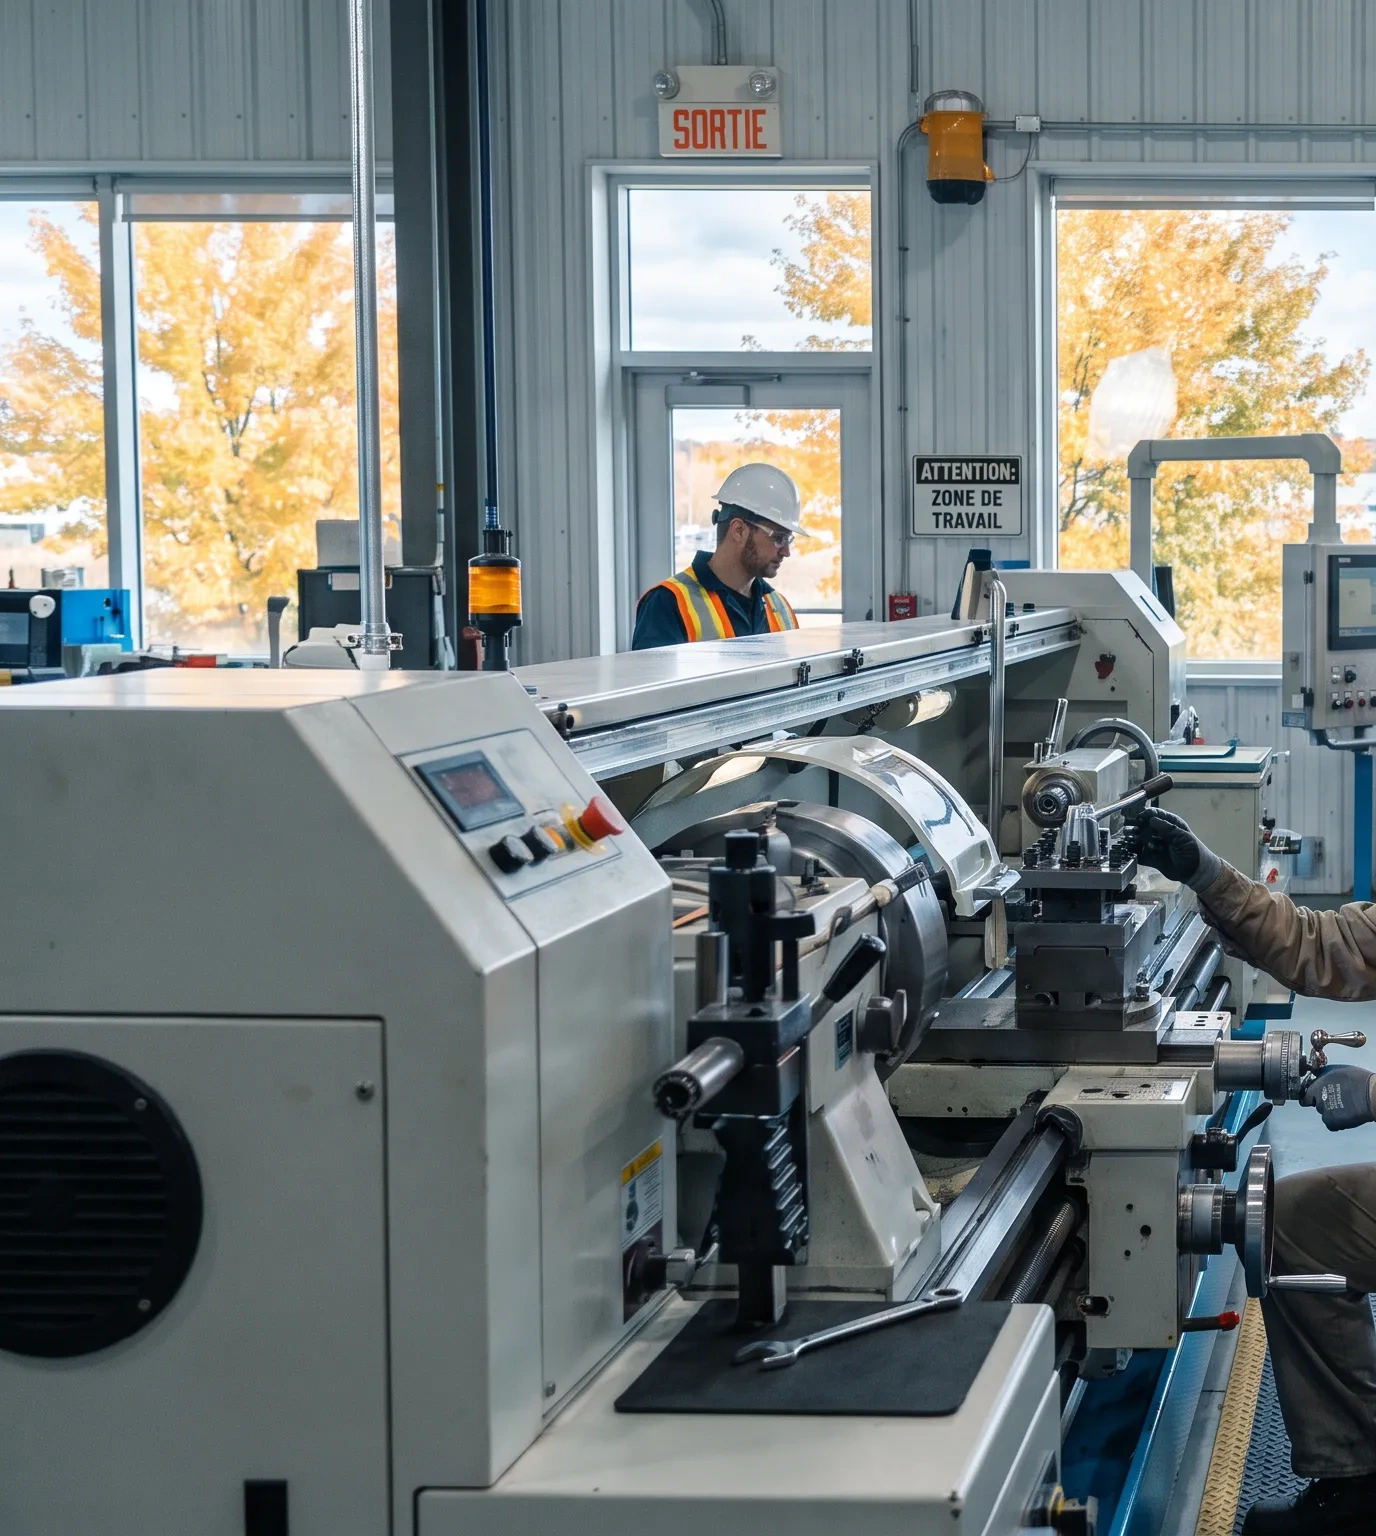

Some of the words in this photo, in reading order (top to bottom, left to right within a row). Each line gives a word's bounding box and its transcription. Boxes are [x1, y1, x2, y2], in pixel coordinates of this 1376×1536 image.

[673, 109, 767, 149] SORTIE
[920, 462, 1016, 480] ATTENTION:
[931, 490, 975, 506] ZONE
[981, 490, 1003, 506] DE
[931, 512, 1003, 529] TRAVAIL
